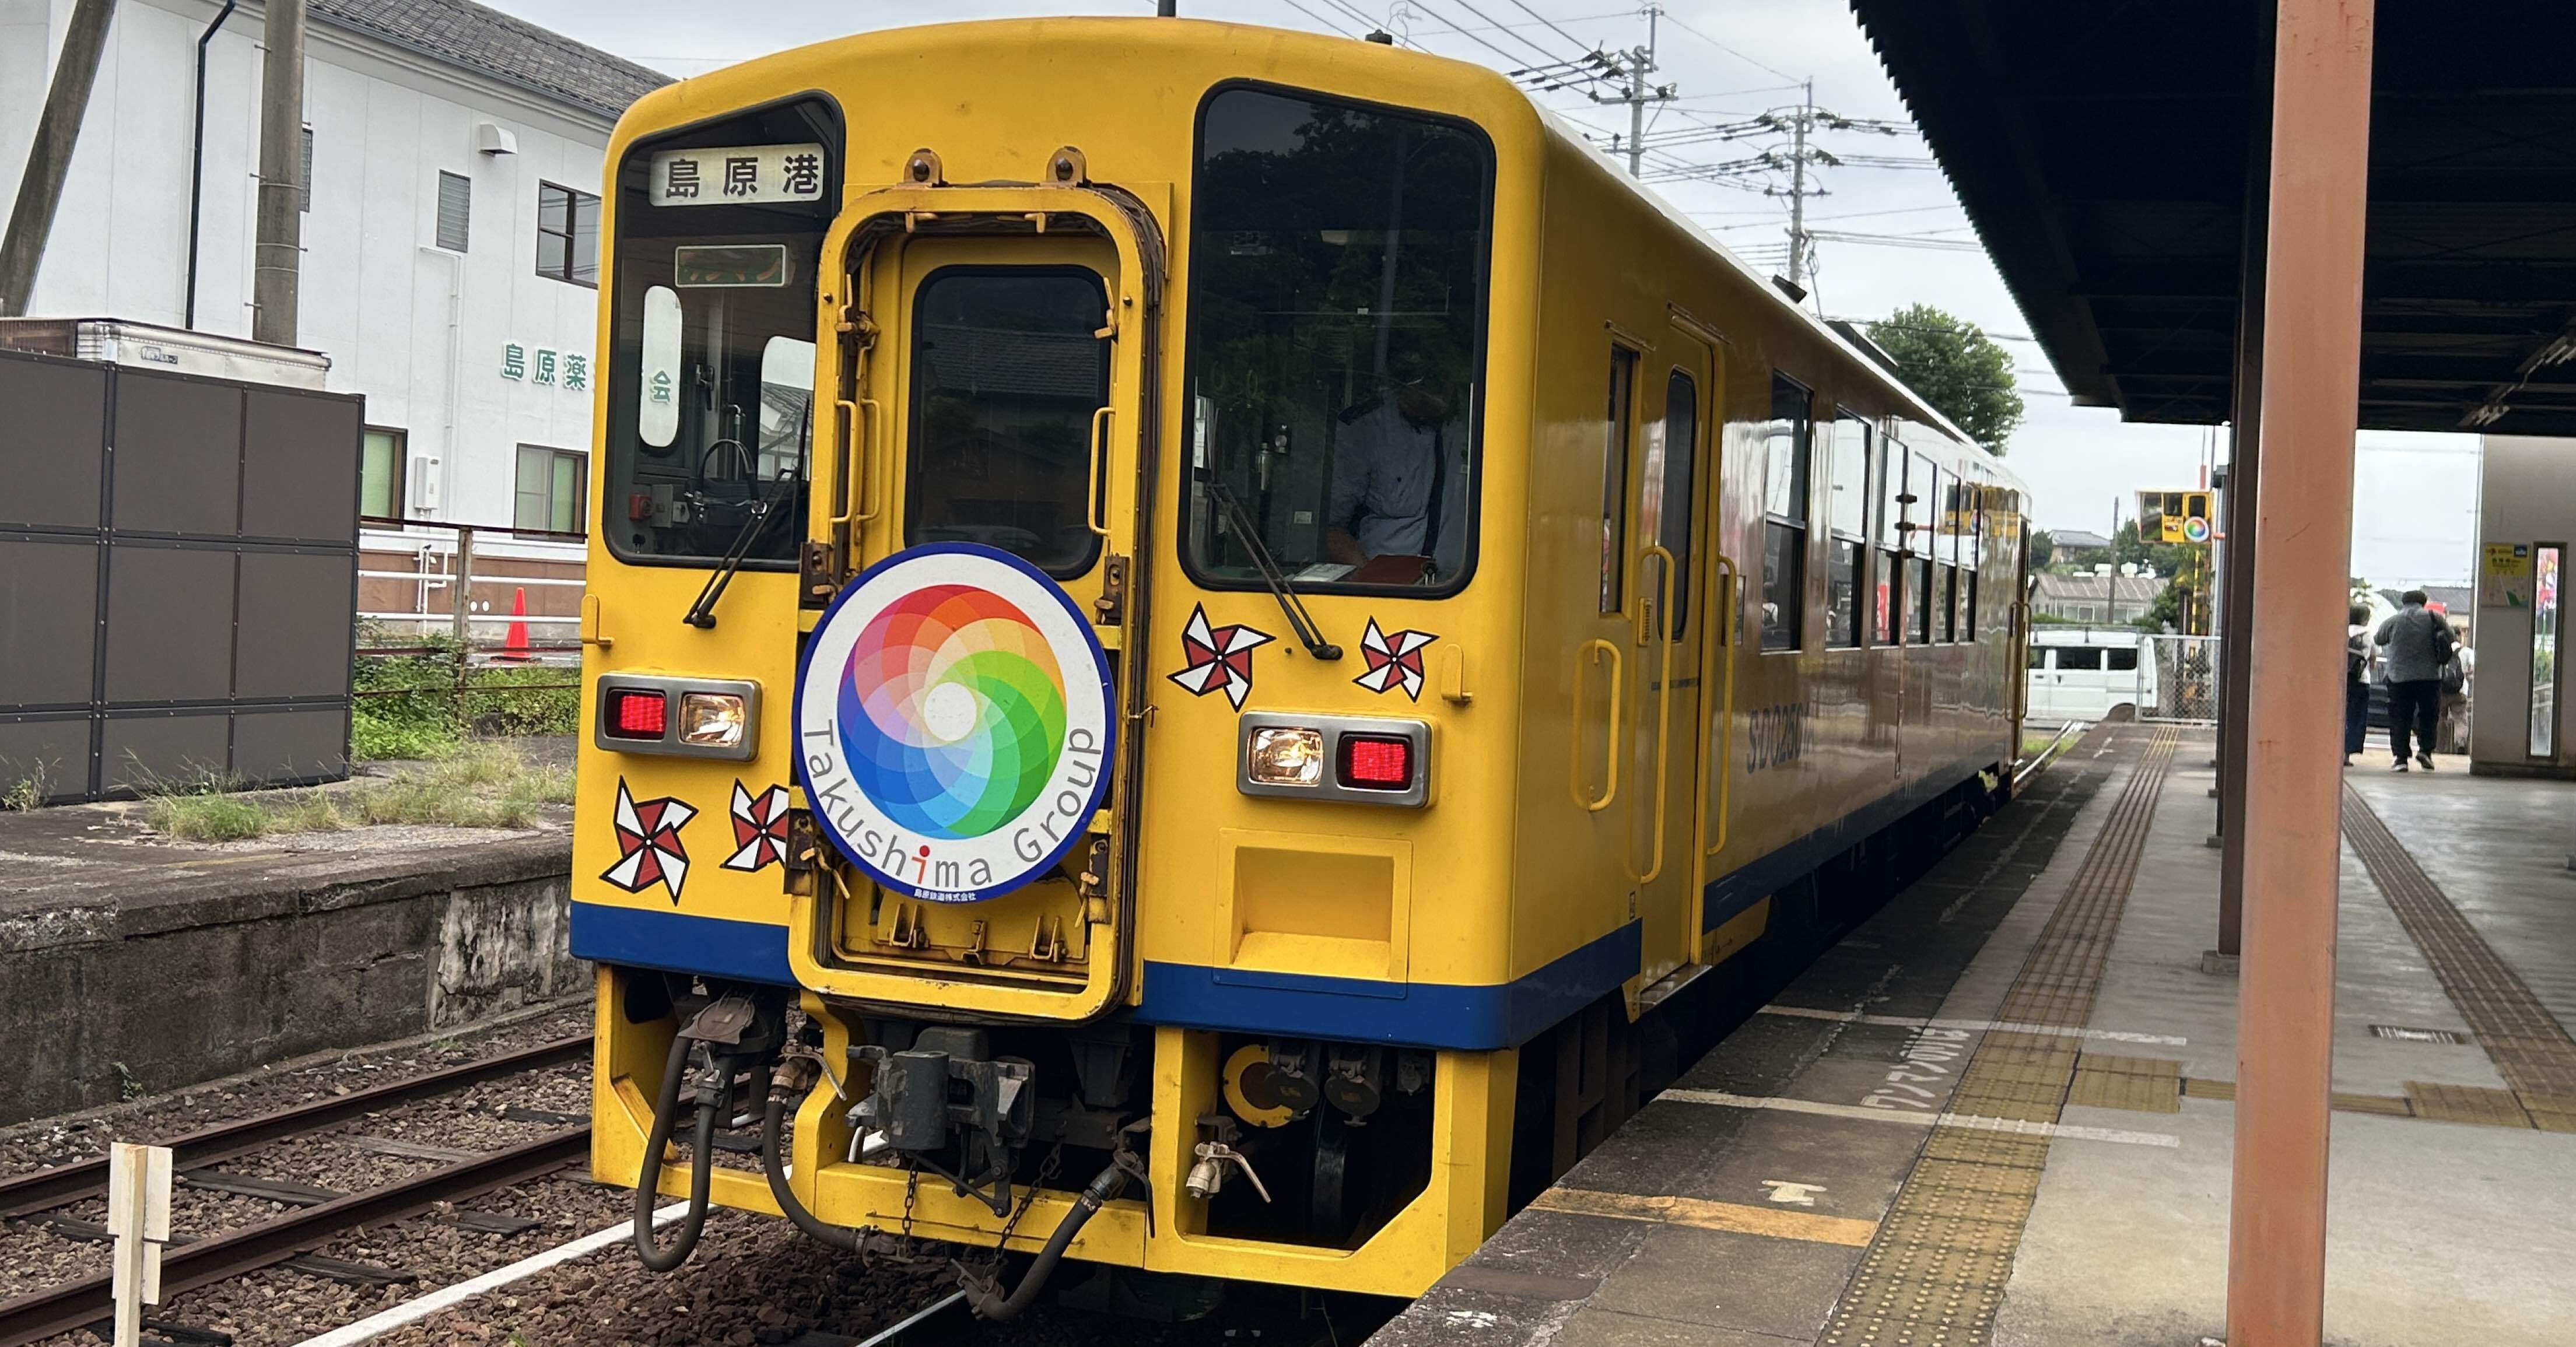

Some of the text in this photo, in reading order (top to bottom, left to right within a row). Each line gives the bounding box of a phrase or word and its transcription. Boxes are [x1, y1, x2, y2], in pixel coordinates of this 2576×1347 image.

[665, 154, 819, 198] 島原港
[804, 719, 1102, 889] Takushima Group
